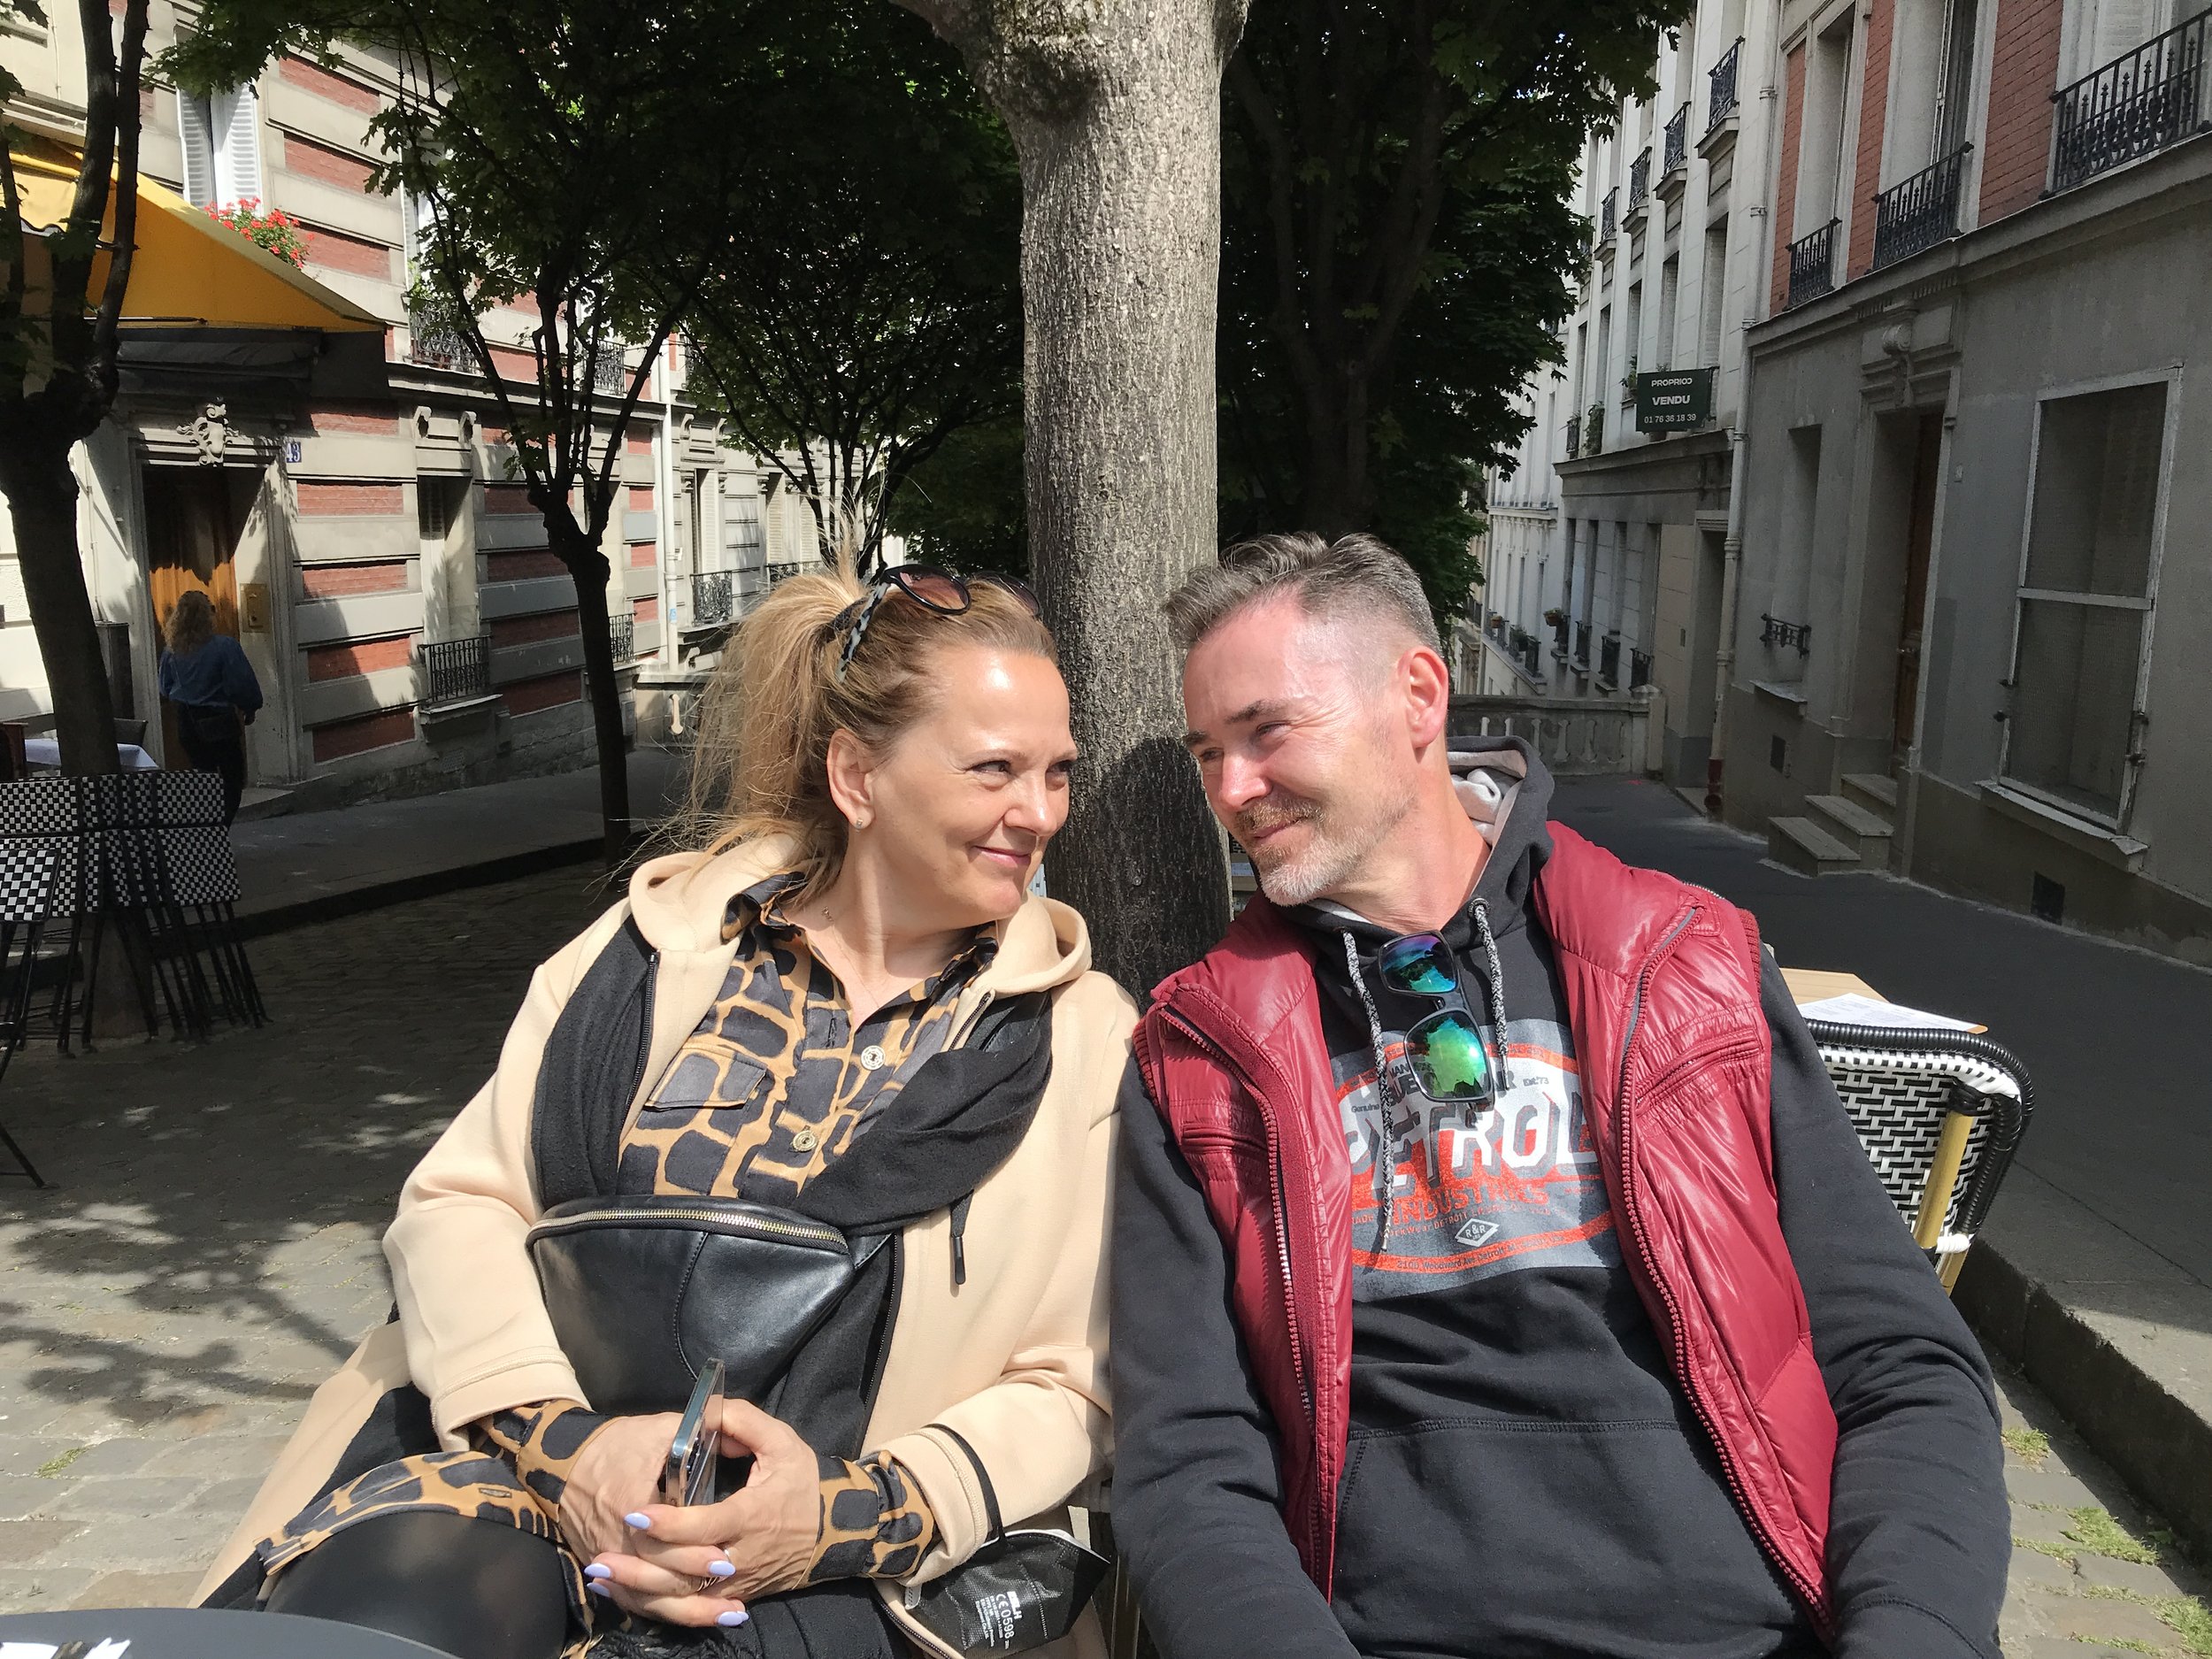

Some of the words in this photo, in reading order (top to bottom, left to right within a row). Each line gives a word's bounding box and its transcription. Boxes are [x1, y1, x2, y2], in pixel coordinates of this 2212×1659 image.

[1652, 395, 1691, 406] VENDU
[1665, 414, 1675, 423] 36
[286, 442, 301, 462] 43
[1351, 1103, 1380, 1113] Genuine
[1465, 1224, 1486, 1239] R&R
[1001, 1609, 1015, 1639] 0598
